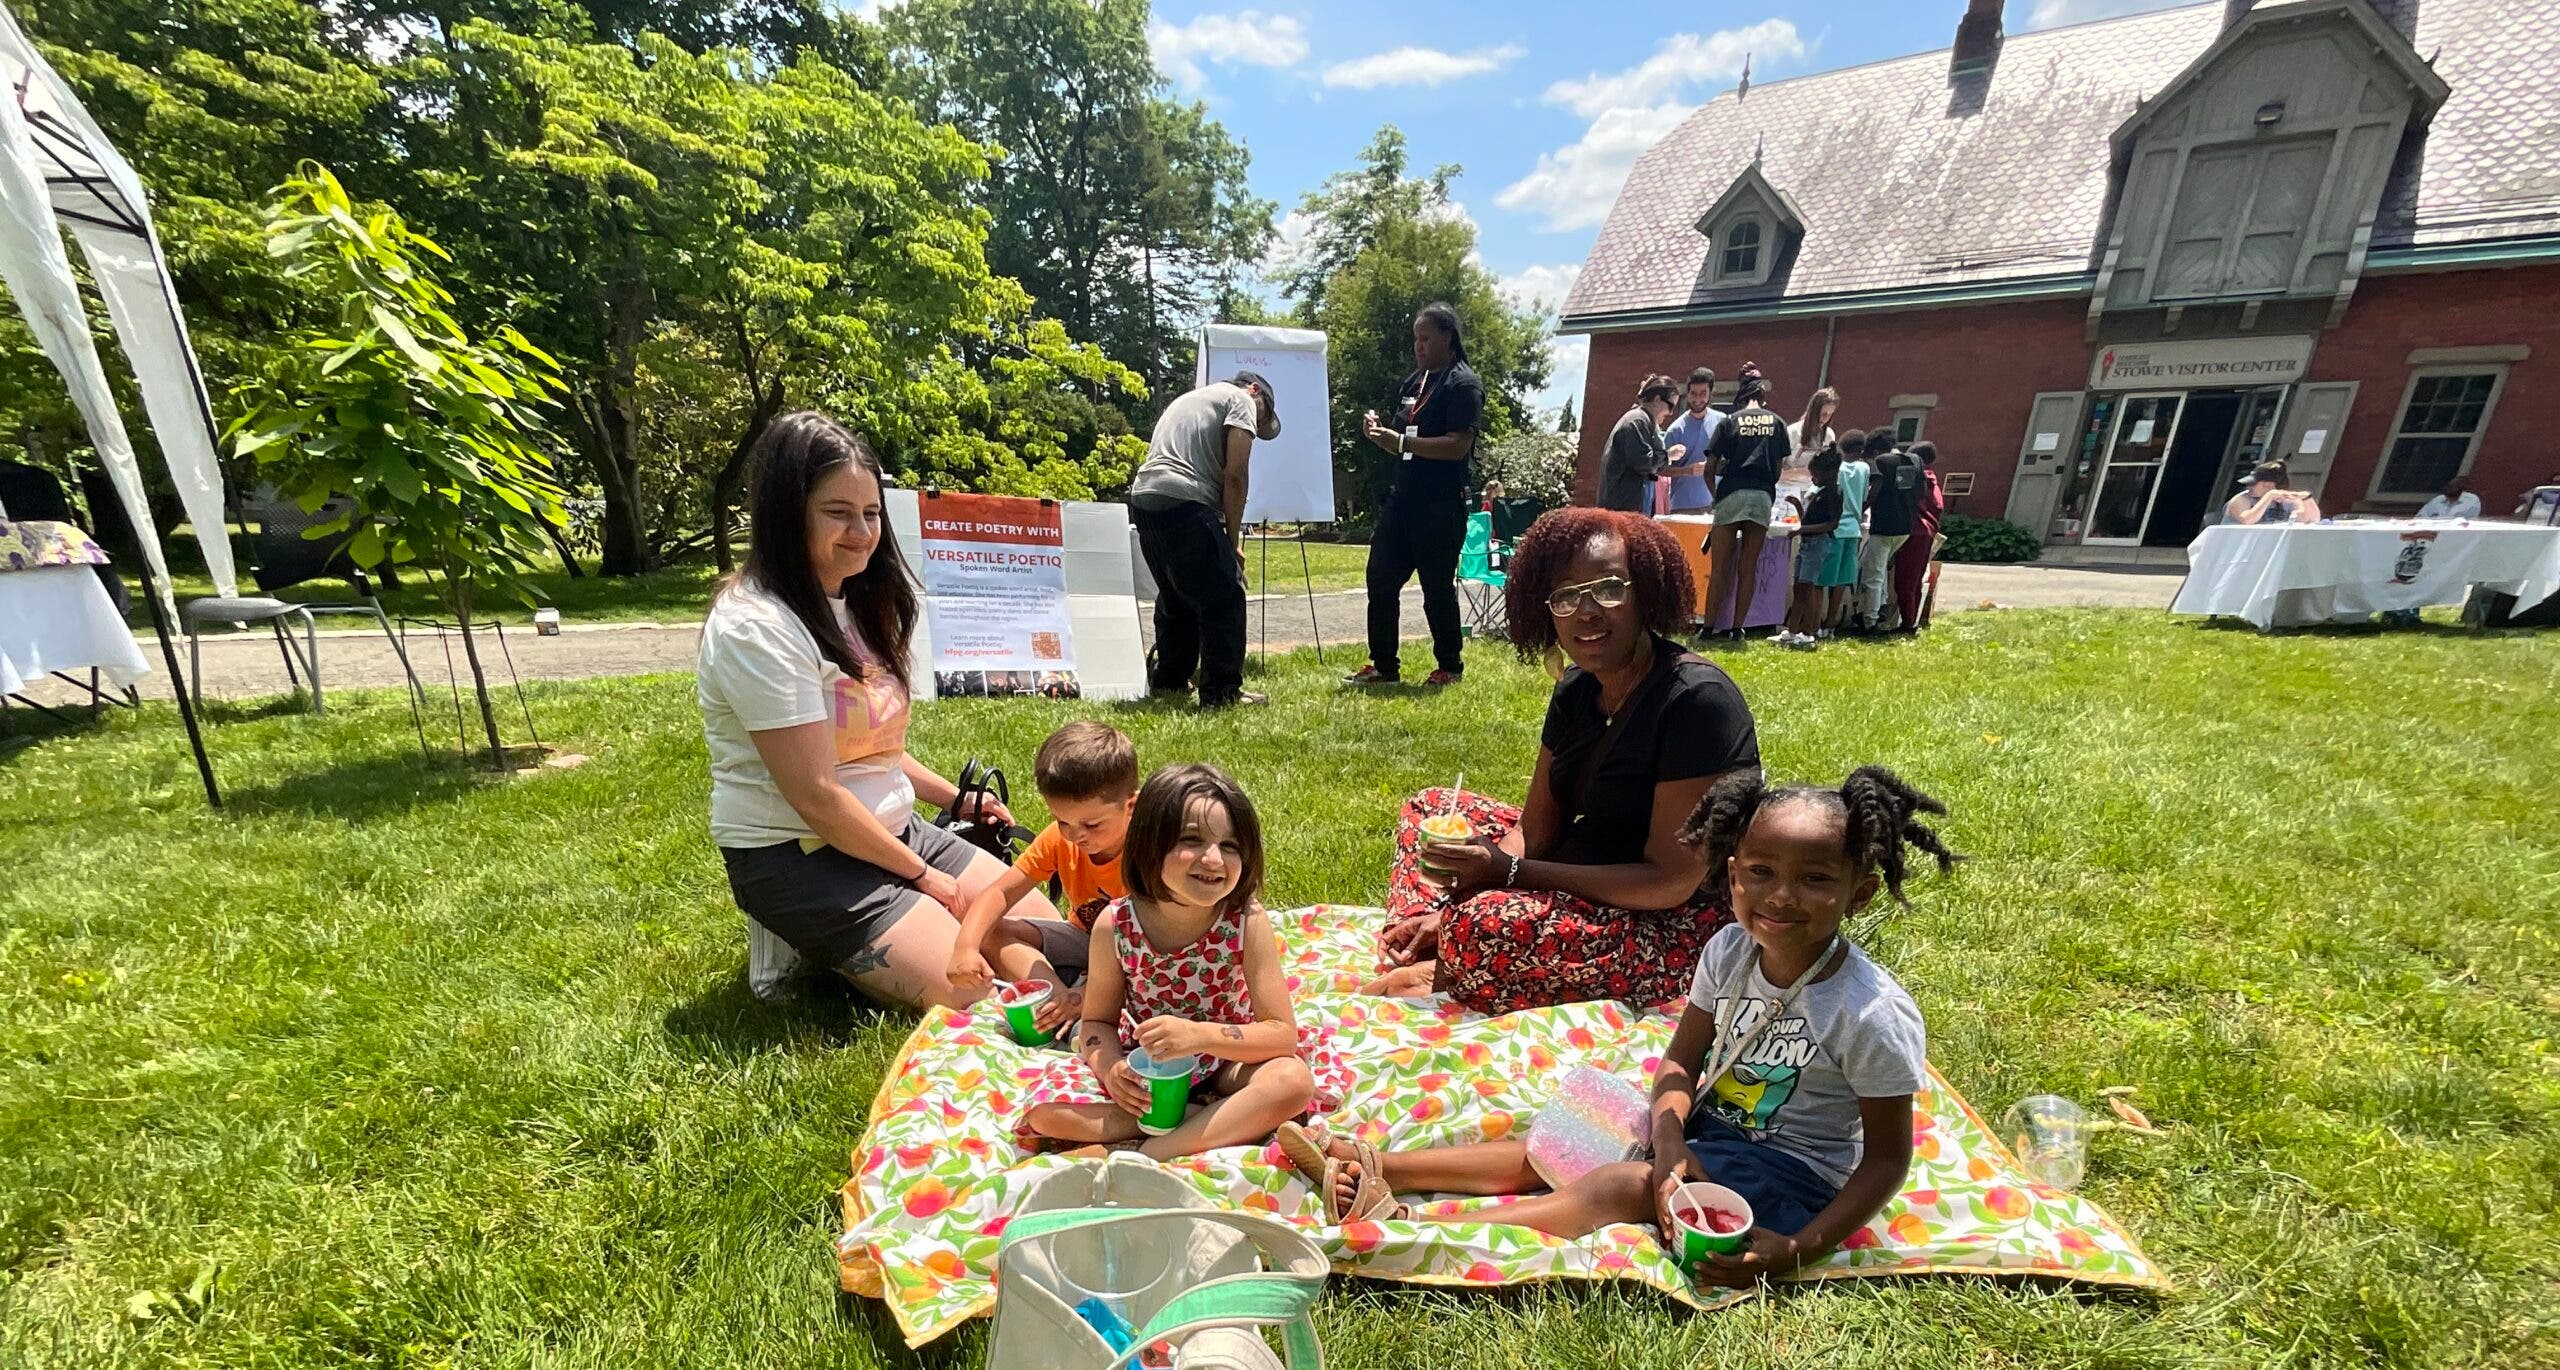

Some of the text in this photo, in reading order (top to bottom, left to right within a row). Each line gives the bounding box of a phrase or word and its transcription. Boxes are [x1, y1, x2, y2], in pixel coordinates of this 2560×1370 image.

[2112, 359, 2297, 378] STOWE VISITOR CENTER
[924, 520, 1060, 538] CREATE POETRY WITH
[926, 549, 1063, 569] VERSATILE POETIQ
[960, 563, 1033, 575] Spoken Word Artist
